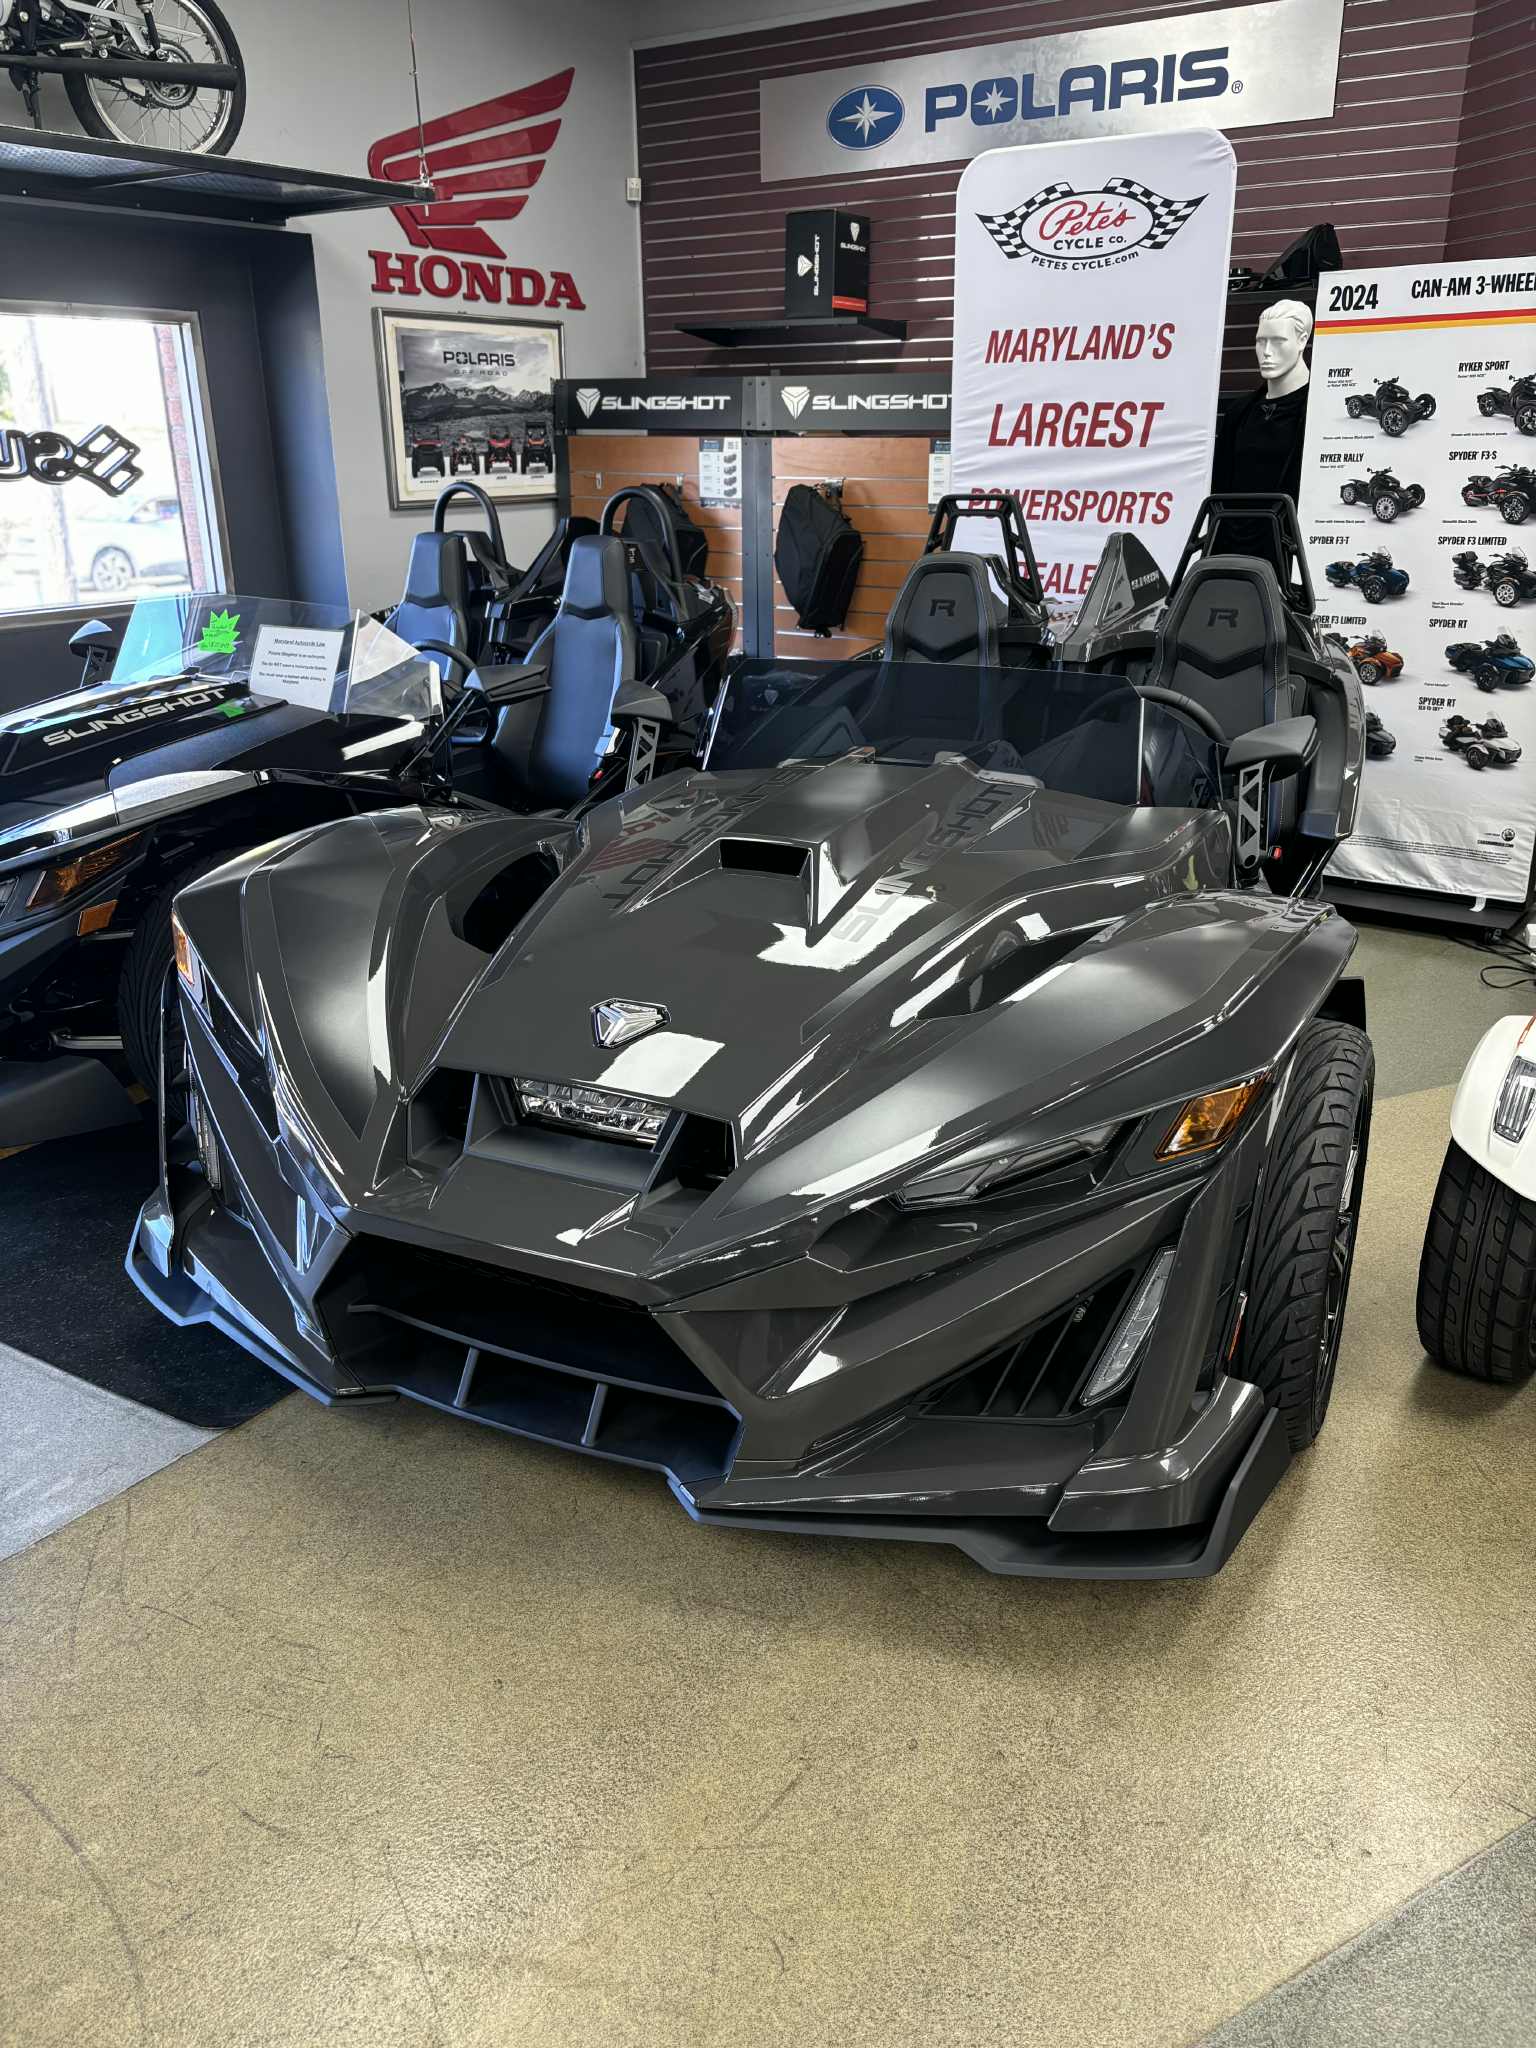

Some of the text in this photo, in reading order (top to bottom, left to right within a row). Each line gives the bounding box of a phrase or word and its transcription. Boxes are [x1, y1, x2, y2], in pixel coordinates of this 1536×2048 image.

[925, 47, 1229, 133] POLARIS
[1039, 200, 1136, 241] Pete's
[1053, 237, 1103, 250] CYCLE
[1031, 250, 1139, 271] PETES CYCLE.com
[368, 249, 586, 311] HONDA
[1329, 272, 1536, 312] 2024 CAN-AM 3-WHEE
[984, 322, 1176, 364] MARYLAND'S
[443, 351, 516, 367] POLARIS
[1458, 360, 1510, 372] RYKER SPORT
[1328, 368, 1351, 378] RYKER
[601, 395, 731, 411] SLINGSHOT
[811, 394, 952, 411] SLINGSHO
[988, 401, 1165, 448] LARGEST
[1320, 453, 1364, 463] RYKER RALLY
[1448, 450, 1497, 461] SPYDER F3-S
[1309, 536, 1335, 545] SPYDER
[1437, 536, 1507, 546] SPYDER F3 LIMITED
[930, 600, 956, 617] R
[1208, 607, 1239, 628] R
[1331, 615, 1339, 624] F3
[1340, 616, 1367, 625] LIMITED
[1429, 618, 1468, 629] SPYDER RT
[1418, 696, 1457, 708] SPYDER RT
[42, 687, 226, 747] SLINGSHOT
